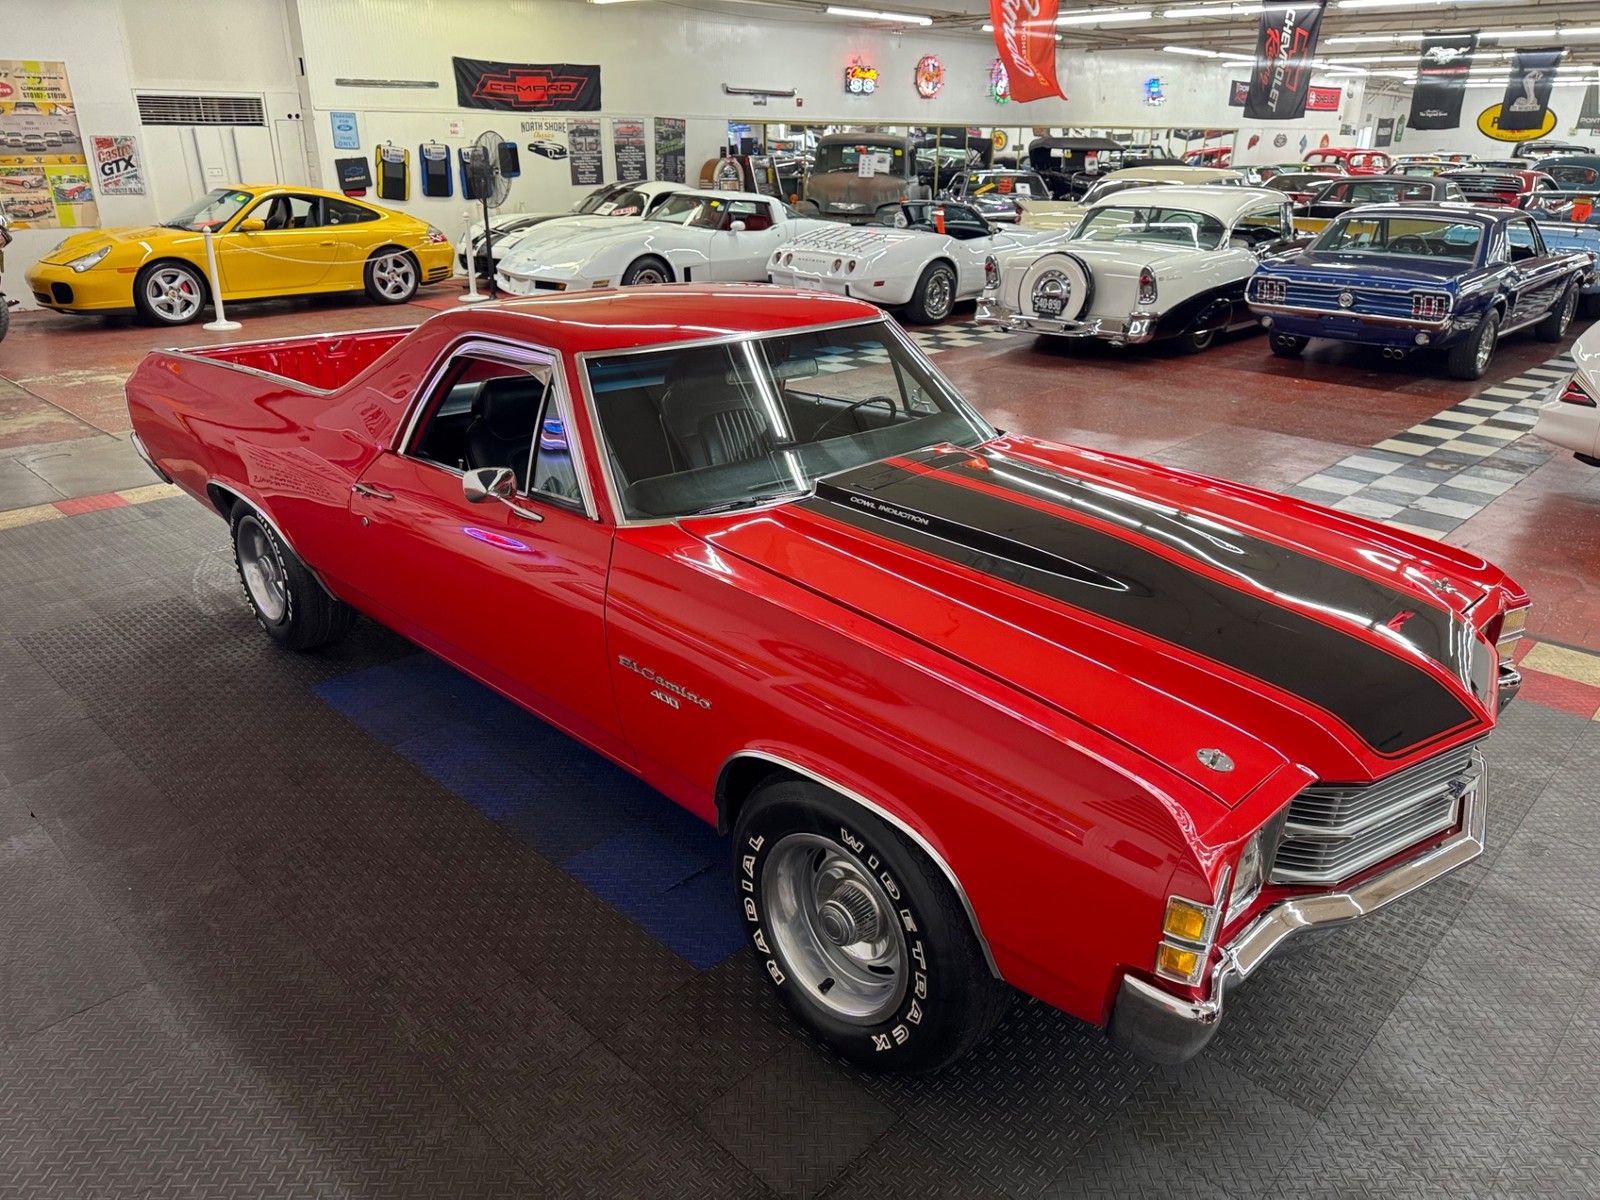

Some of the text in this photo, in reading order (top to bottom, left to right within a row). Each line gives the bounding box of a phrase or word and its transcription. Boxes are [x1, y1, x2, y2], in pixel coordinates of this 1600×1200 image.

[1260, 27, 1281, 92] Racing
[1267, 8, 1296, 113] CHEVROLET
[490, 83, 572, 93] CAMARO
[520, 121, 543, 133] NORTH
[544, 121, 567, 133] SHORE
[97, 144, 134, 163] Castro
[100, 154, 136, 176] GTX
[849, 496, 930, 525] COWL INDUCTION
[650, 689, 681, 710] 400
